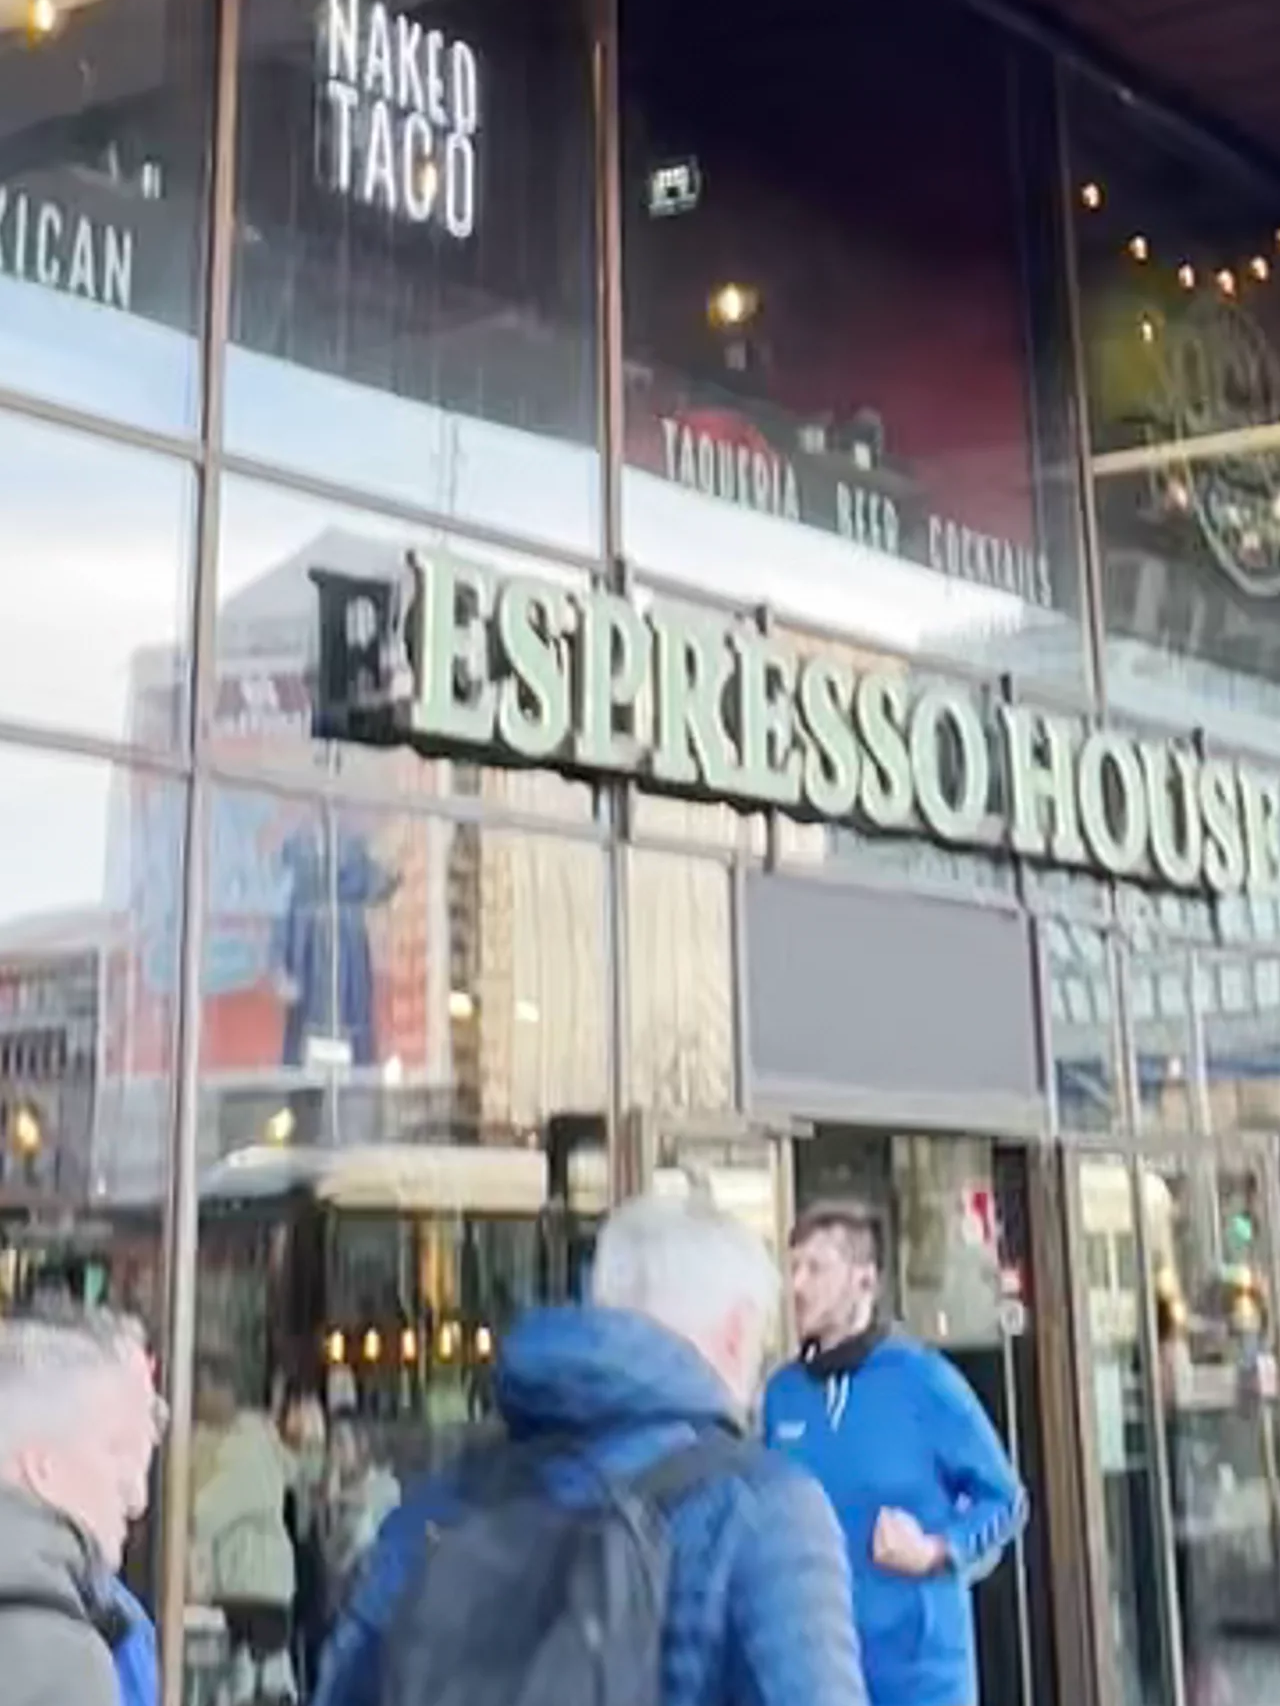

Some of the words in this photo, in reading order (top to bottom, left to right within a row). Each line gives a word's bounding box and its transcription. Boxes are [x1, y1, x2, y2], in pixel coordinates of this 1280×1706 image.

[327, 79, 476, 239] TACO
[660, 417, 801, 523] TAQUERIA
[836, 481, 900, 556] BEER
[412, 552, 989, 839] ESPRESSO
